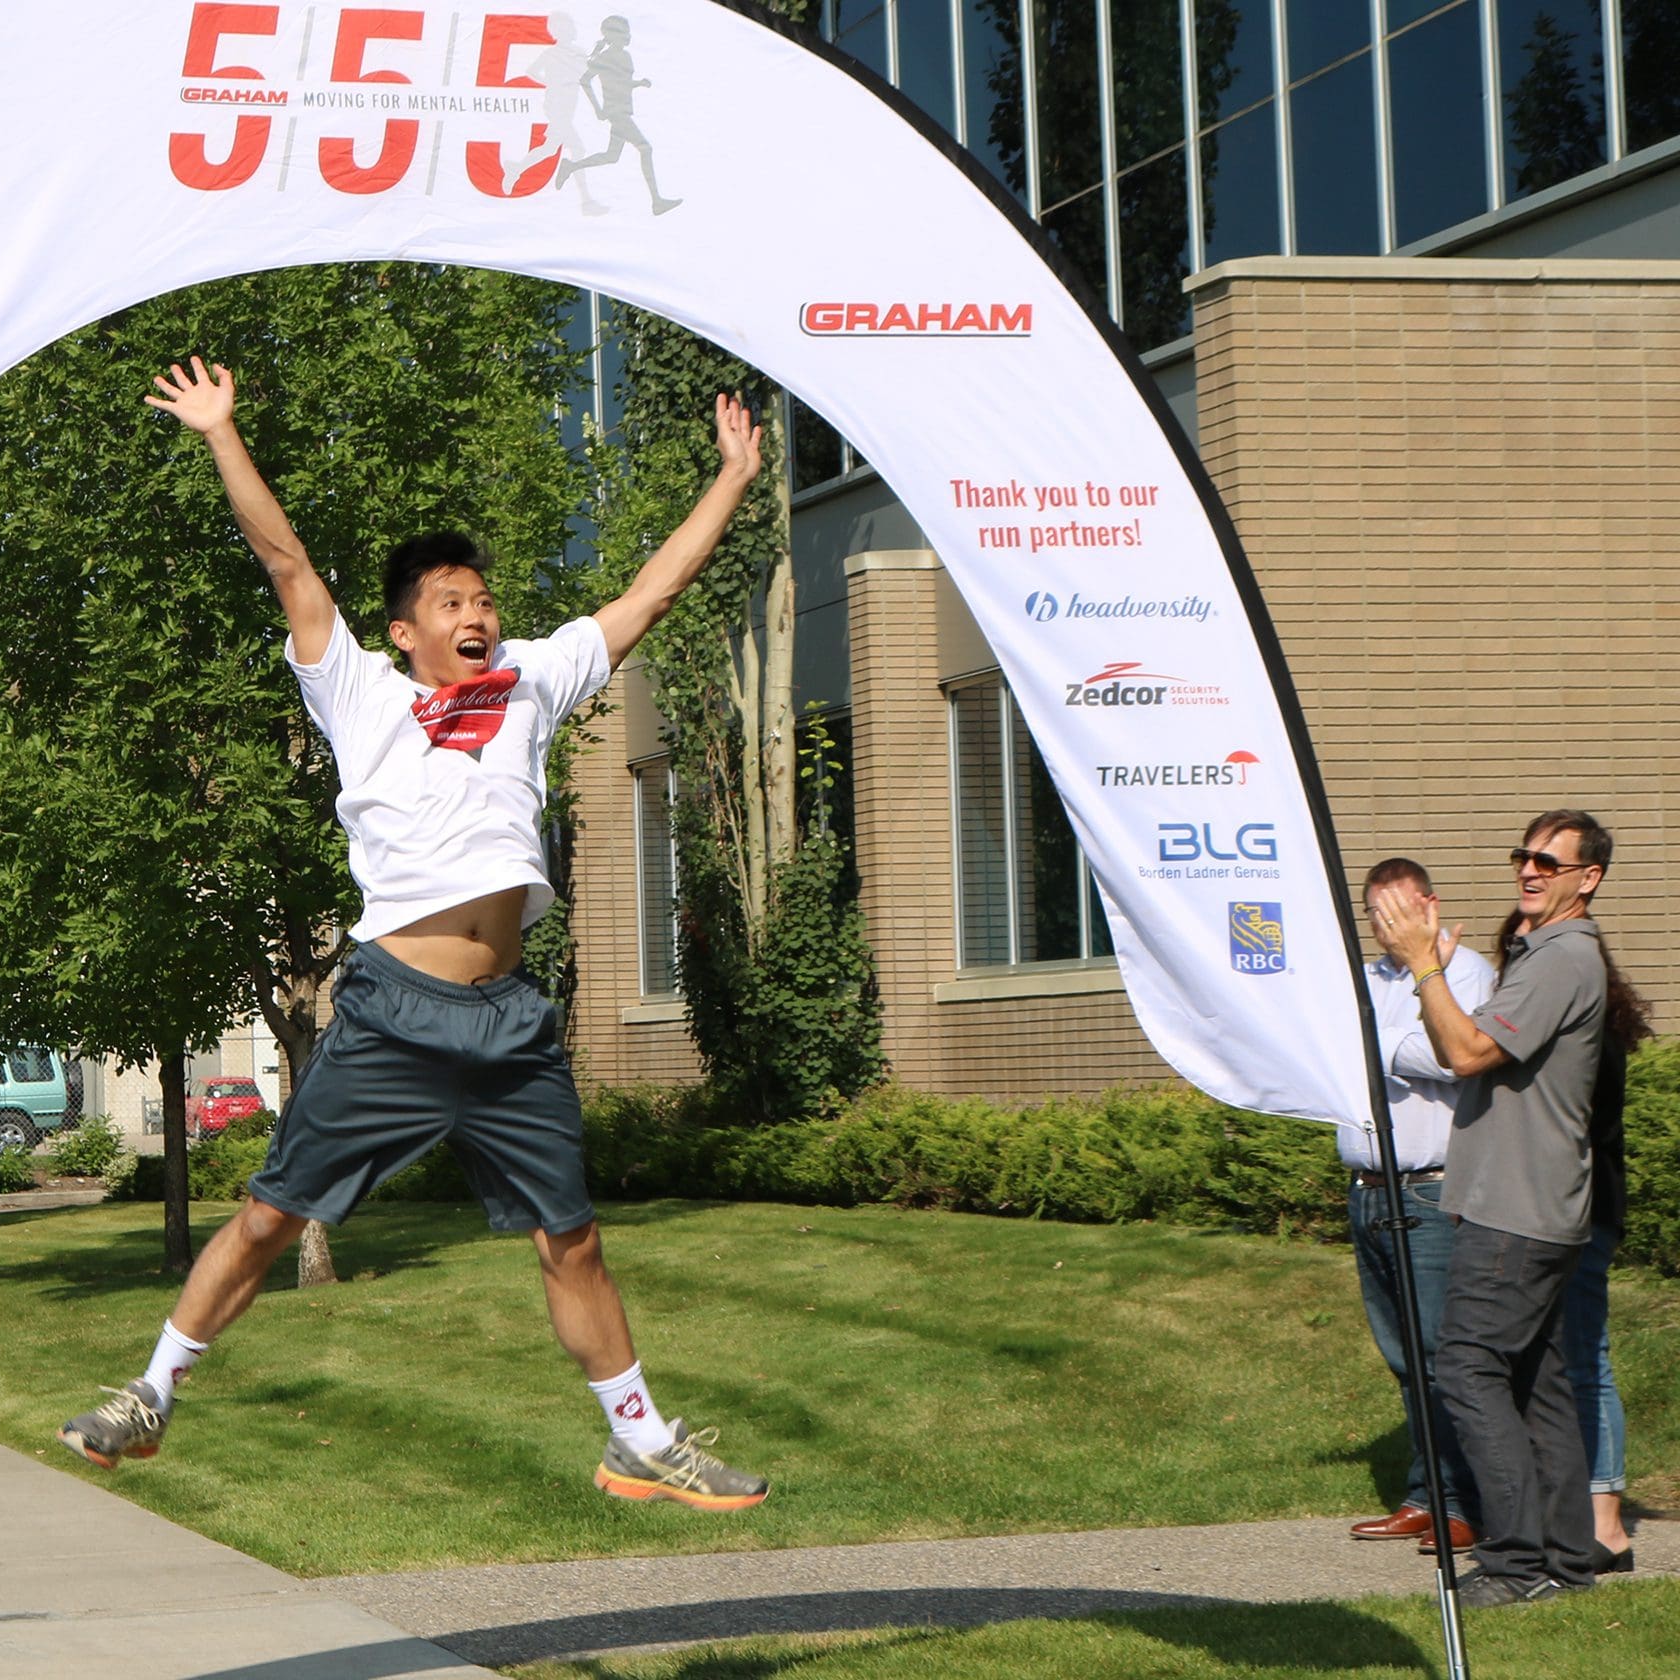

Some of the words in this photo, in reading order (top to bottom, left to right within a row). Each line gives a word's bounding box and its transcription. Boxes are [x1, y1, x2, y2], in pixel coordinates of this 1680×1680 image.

[182, 87, 288, 104] GRAHAM
[303, 91, 365, 109] MOVING
[372, 93, 401, 109] FOR
[408, 95, 466, 112] MENTAL
[473, 97, 530, 113] HEALTH
[804, 302, 1033, 332] GRAHAM
[950, 479, 1028, 508] Thank
[1034, 485, 1078, 512] you
[1085, 481, 1110, 507] to
[1119, 485, 1159, 507] our
[979, 526, 1021, 548] run
[1030, 518, 1143, 553] partners!
[1065, 592, 1212, 623] headversity
[1065, 681, 1168, 706] Zedcor
[1170, 685, 1221, 694] SECURITY
[1171, 697, 1230, 705] SOLUTIONS
[437, 731, 477, 740] GRAHAM
[1096, 765, 1234, 787] TRAVELERS
[1158, 822, 1278, 862] BLG
[1138, 866, 1181, 880] Borden
[1186, 866, 1230, 879] Ladner
[1234, 866, 1280, 880] Gervais
[1235, 953, 1283, 970] RBC
